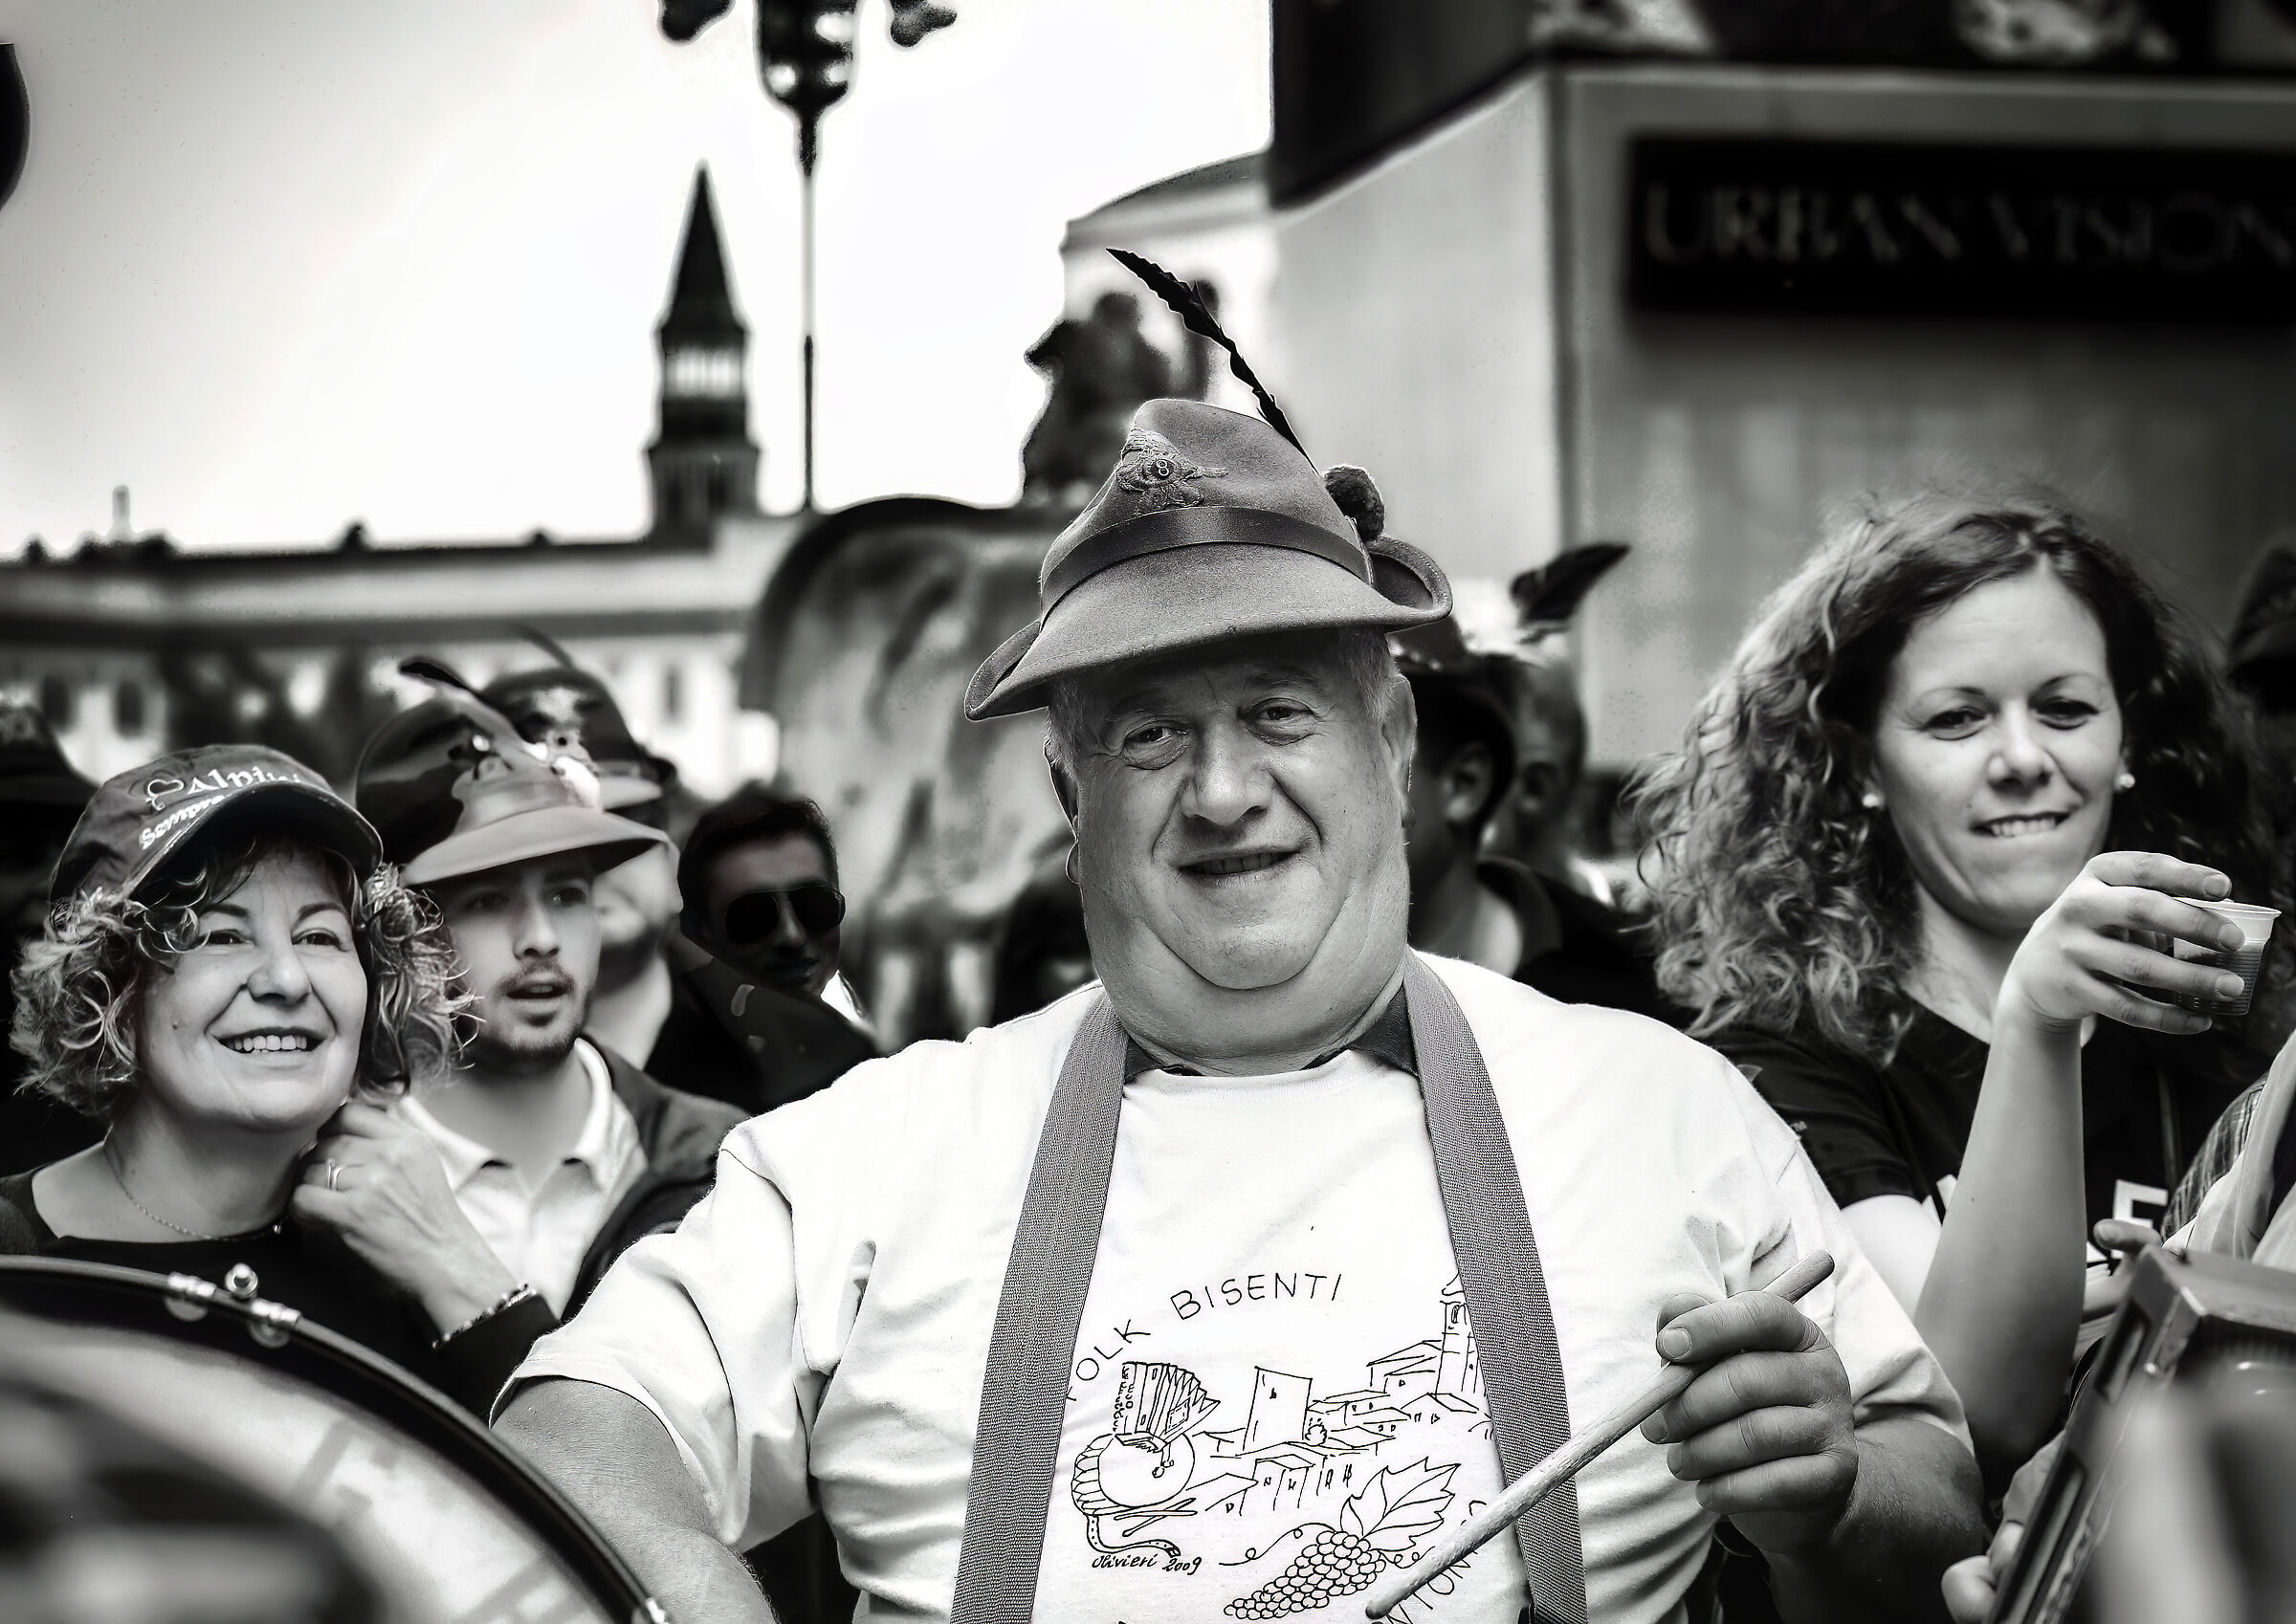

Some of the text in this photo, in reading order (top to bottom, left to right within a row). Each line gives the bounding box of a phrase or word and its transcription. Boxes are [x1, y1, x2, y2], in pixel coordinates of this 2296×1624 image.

[1645, 180, 2295, 274] URBAN VISION
[1156, 459, 1169, 476] 8
[1170, 1273, 1343, 1320] BISENTI
[1162, 1556, 1203, 1576] 2009
